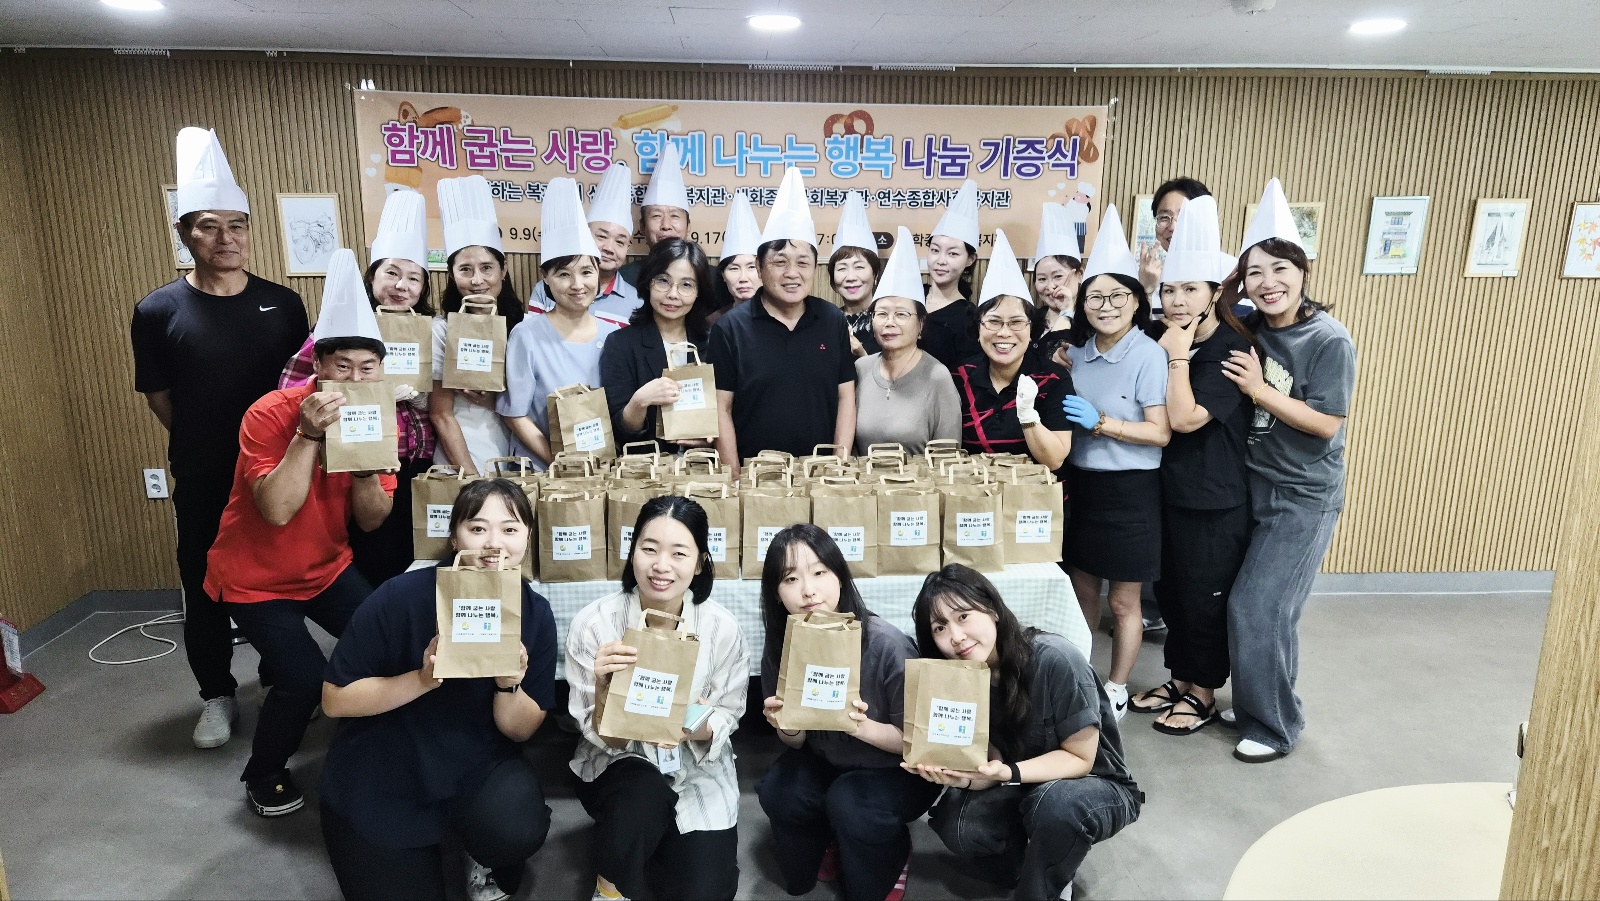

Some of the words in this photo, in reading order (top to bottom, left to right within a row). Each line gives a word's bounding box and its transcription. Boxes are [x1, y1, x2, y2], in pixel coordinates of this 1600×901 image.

[382, 121, 457, 169] 함께
[462, 126, 537, 171] 굽는
[633, 130, 706, 176] 함께
[713, 131, 820, 178] 나누는
[824, 134, 896, 179] 행복
[903, 135, 973, 179] 나눔
[977, 135, 1080, 179] 기증식
[490, 182, 523, 202] 하는
